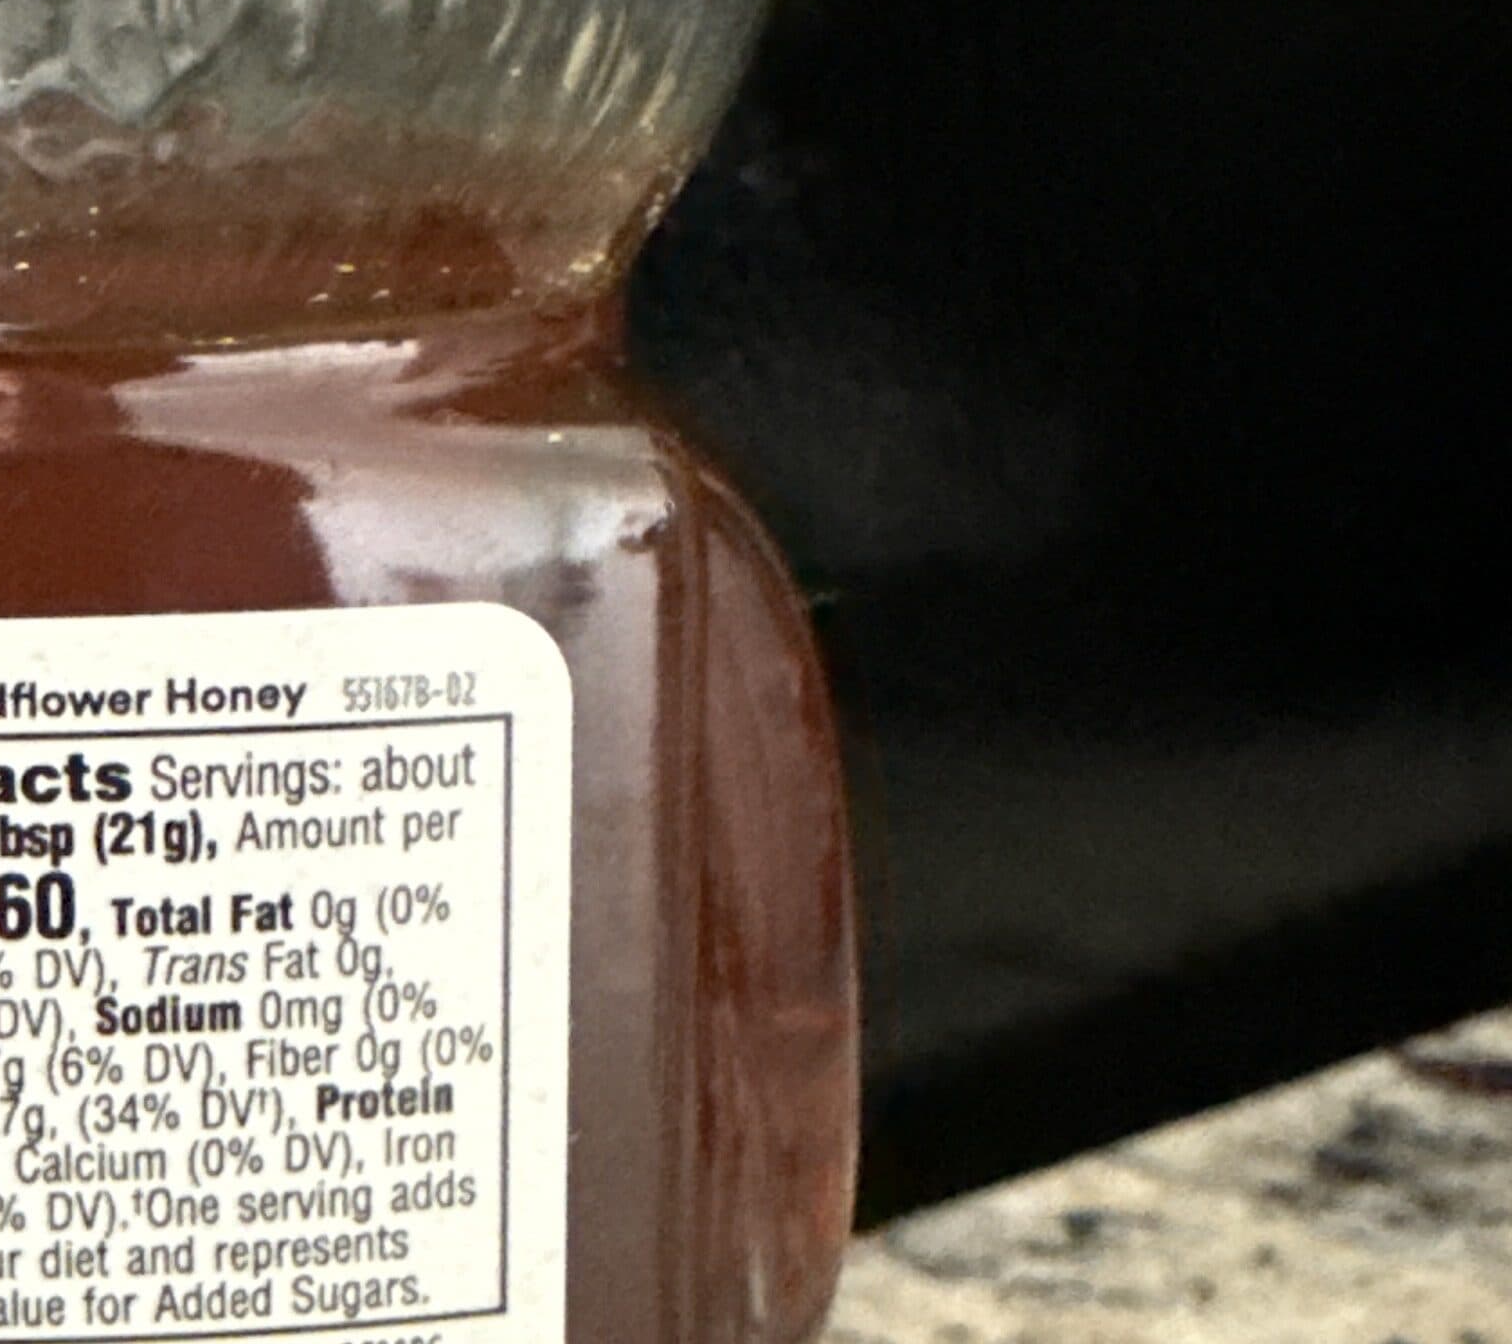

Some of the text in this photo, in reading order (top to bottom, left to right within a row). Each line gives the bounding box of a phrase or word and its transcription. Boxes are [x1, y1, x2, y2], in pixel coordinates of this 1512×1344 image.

[167, 677, 307, 719] Honey
[150, 752, 342, 806] Servings:
[361, 744, 475, 792] about
[93, 809, 218, 865] (21g),
[235, 807, 385, 853] Amount
[402, 806, 462, 852] per
[111, 894, 212, 938] Total
[230, 892, 294, 933] Fat
[310, 889, 357, 936] 0g
[377, 882, 451, 935] (0%
[35, 947, 118, 998] DV),
[143, 944, 249, 986] Trans
[264, 939, 320, 982] Fat
[95, 995, 242, 1037] Sodium
[258, 990, 342, 1035] 0mg
[364, 979, 438, 1031] (0%
[48, 1045, 124, 1096] (6%
[145, 1042, 227, 1091] DV),
[247, 1038, 339, 1080] Fiber
[356, 1033, 402, 1080] 0g
[421, 1024, 494, 1078] (0%
[78, 1093, 180, 1141] (34%
[316, 1083, 453, 1123] Protein
[15, 1144, 167, 1185] Calcium
[188, 1137, 264, 1187] (0%
[286, 1131, 365, 1177] DV),
[385, 1127, 456, 1166] Iron
[238, 1182, 373, 1224] serving
[391, 1171, 476, 1214] adds
[41, 1242, 109, 1278] diet
[127, 1236, 195, 1276] and
[216, 1227, 409, 1277] represents
[84, 1286, 138, 1325] for
[154, 1279, 273, 1323] Added
[291, 1273, 430, 1319] Sugars.
